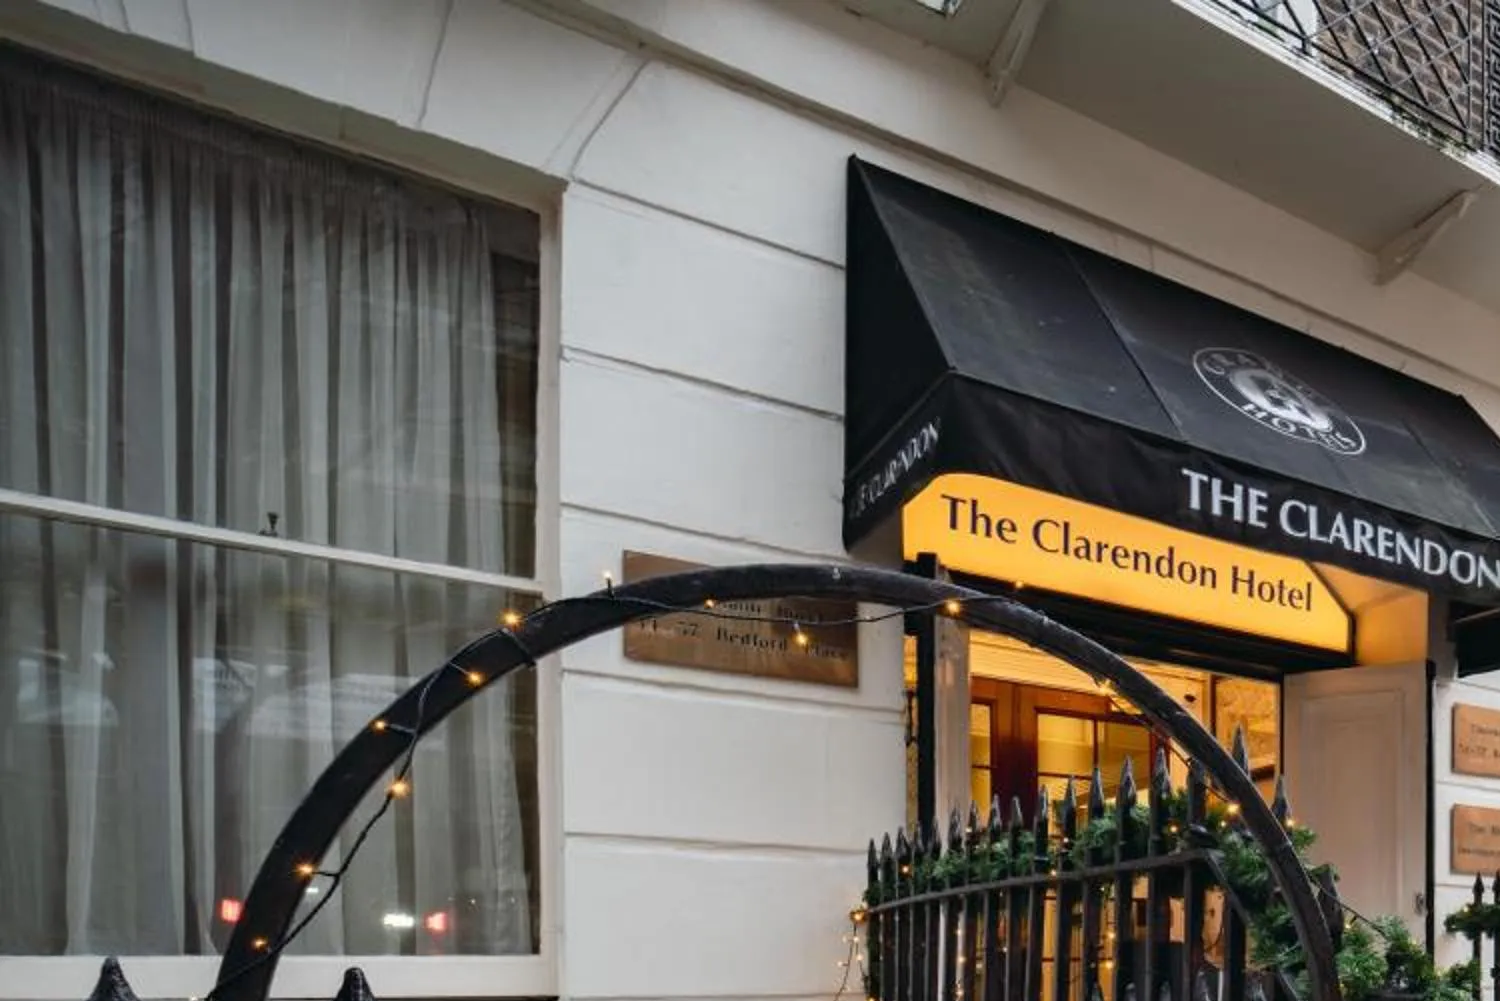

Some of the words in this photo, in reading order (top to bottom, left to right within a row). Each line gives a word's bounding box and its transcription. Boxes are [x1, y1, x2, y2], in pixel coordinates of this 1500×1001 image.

[1182, 467, 1269, 528] THE
[941, 493, 1018, 544] The
[1032, 518, 1217, 590] Clarendon
[1231, 564, 1313, 612] Hotel
